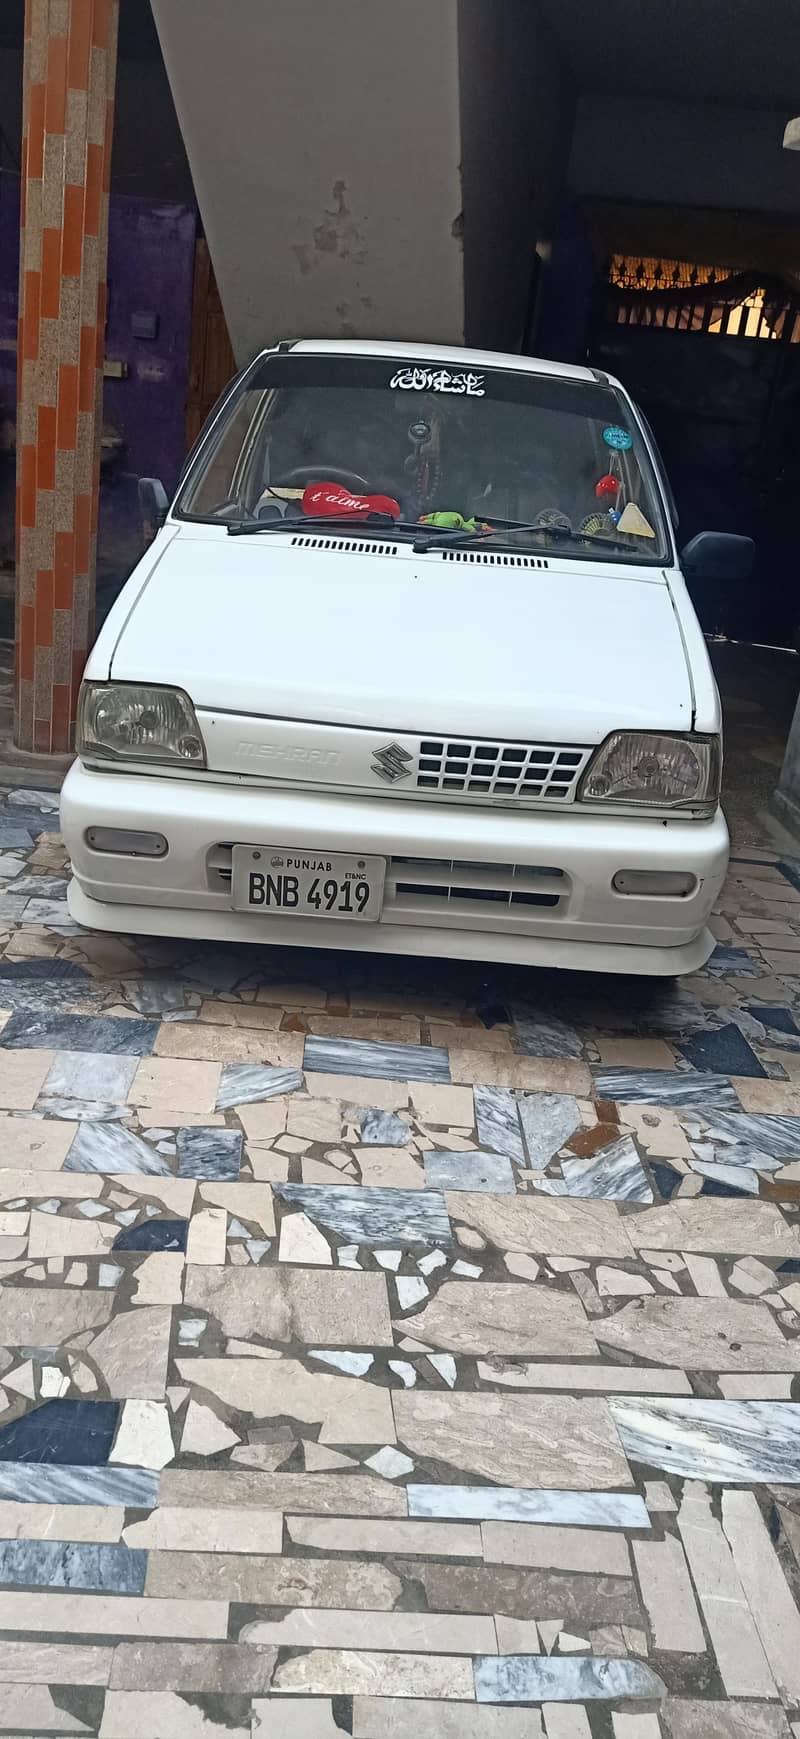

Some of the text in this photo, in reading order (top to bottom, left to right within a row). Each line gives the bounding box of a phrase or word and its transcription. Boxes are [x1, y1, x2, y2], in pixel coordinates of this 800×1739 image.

[234, 740, 343, 767] MEHRAN
[286, 858, 332, 872] PUNJAB
[249, 872, 370, 913] BNB 4919
